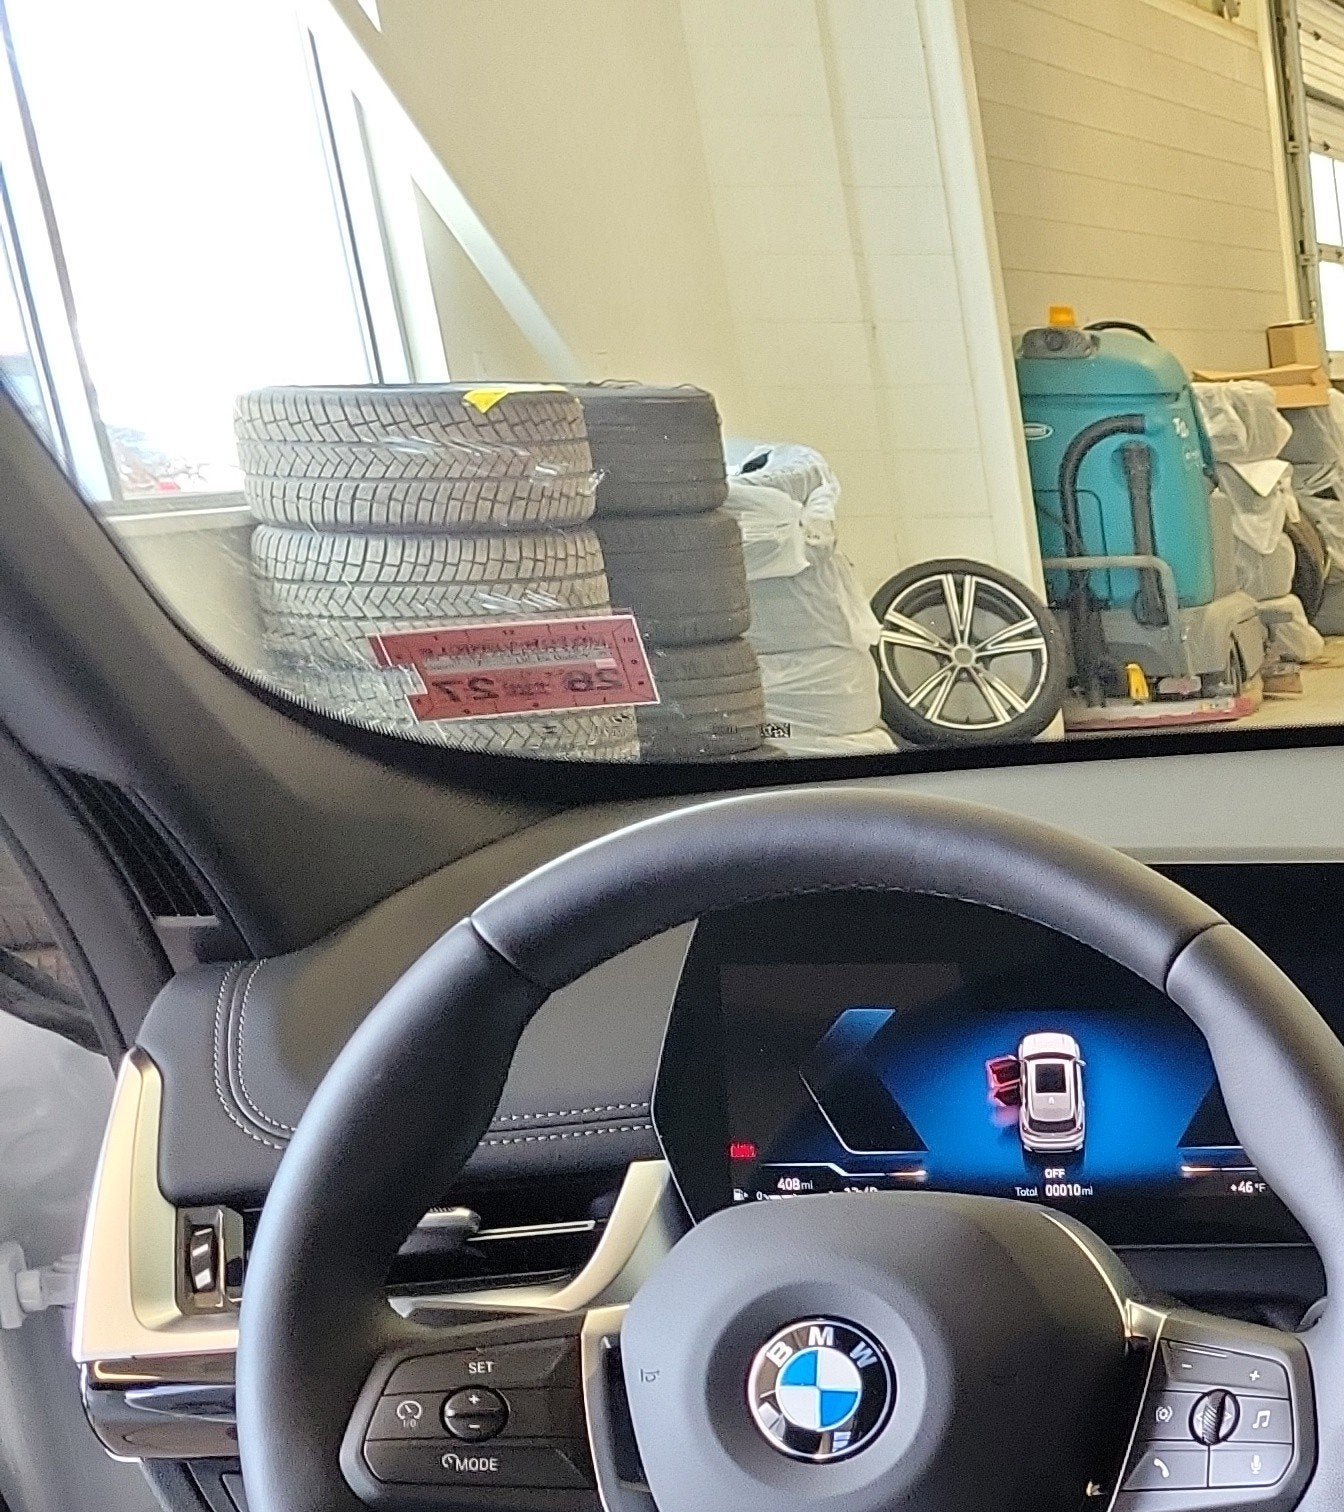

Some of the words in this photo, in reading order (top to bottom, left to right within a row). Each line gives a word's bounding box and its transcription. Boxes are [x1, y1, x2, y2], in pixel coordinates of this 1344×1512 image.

[1044, 1168, 1066, 1179] OFF
[1015, 1185, 1038, 1196] Total
[766, 1326, 877, 1368] BMW
[468, 1361, 495, 1374] SET
[455, 1458, 499, 1472] MODE
